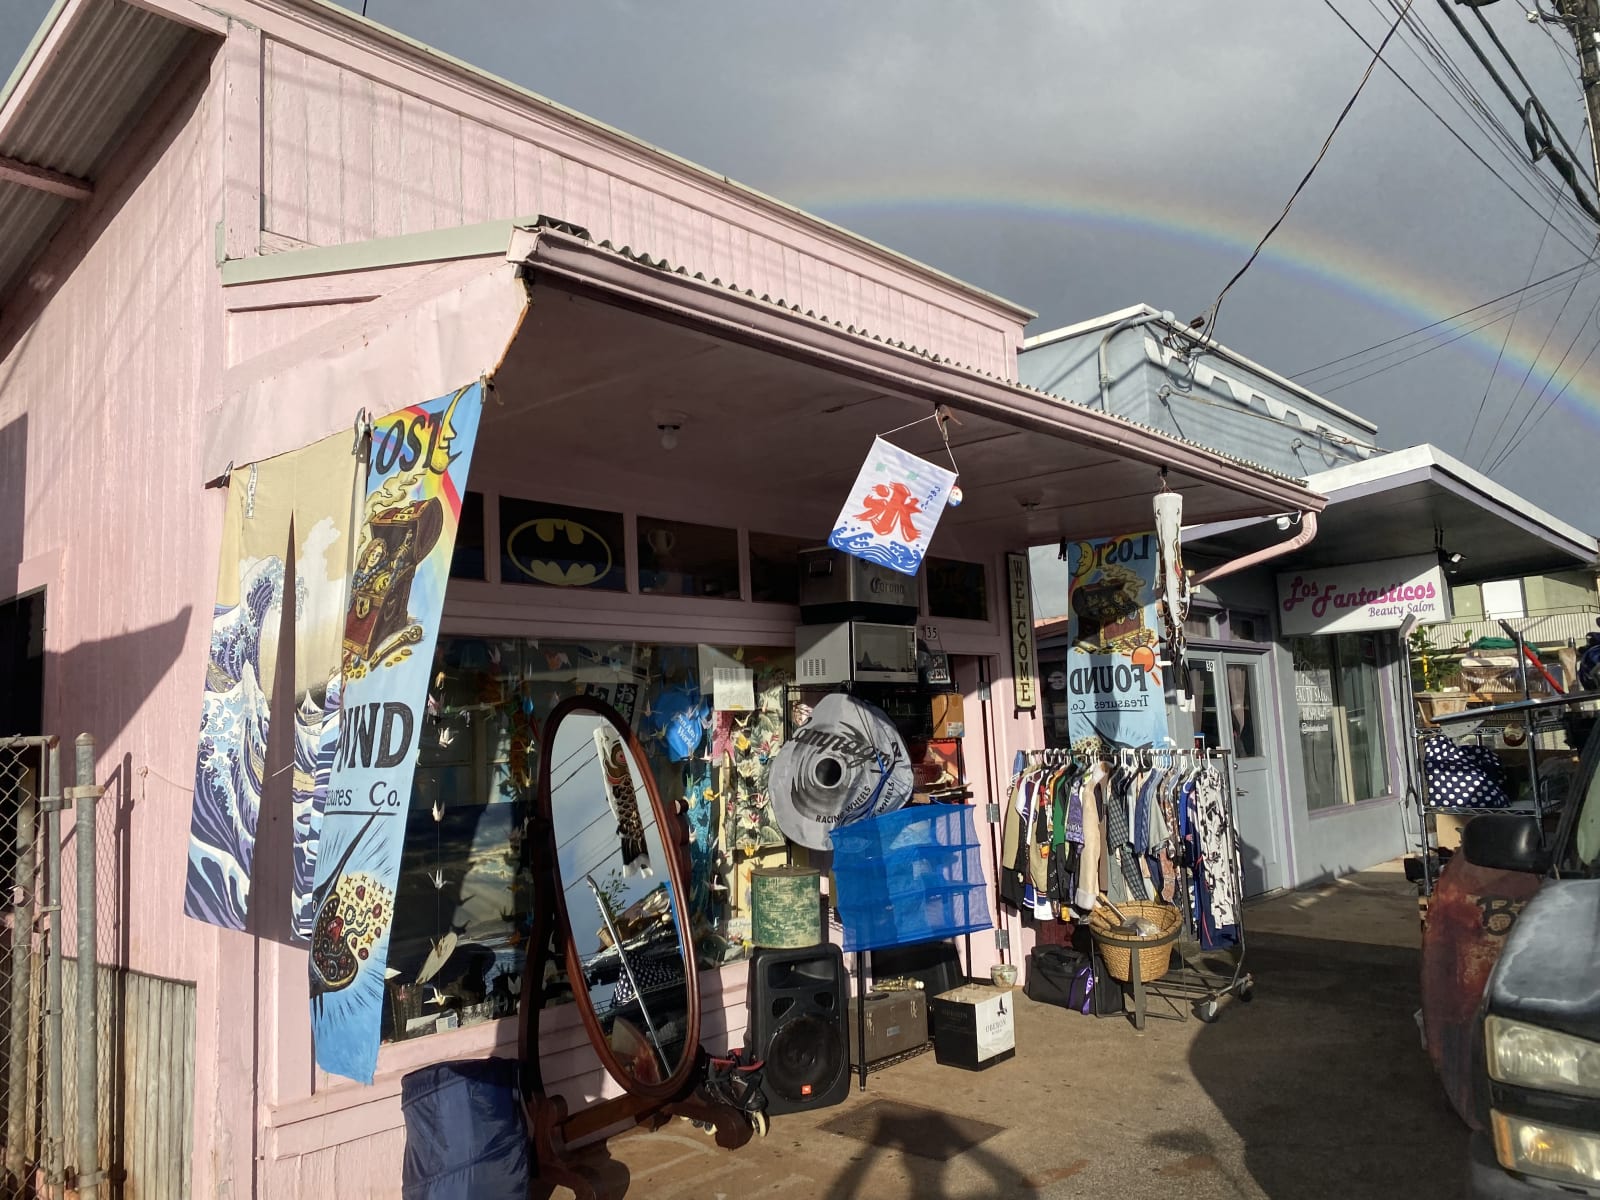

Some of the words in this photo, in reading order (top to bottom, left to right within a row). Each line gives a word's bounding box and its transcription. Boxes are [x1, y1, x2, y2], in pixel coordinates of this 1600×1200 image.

[367, 409, 444, 475] OST
[870, 577, 905, 594] Corona
[1283, 575, 1318, 611] Los
[1311, 581, 1436, 618] Fantasticos
[1368, 605, 1404, 617] Beauty
[1407, 601, 1435, 615] Salon
[927, 626, 937, 639] 35
[1013, 559, 1031, 701] WELCOME
[369, 781, 400, 807] Co.
[845, 785, 871, 813] WHEELS
[879, 782, 895, 814] WHEELS
